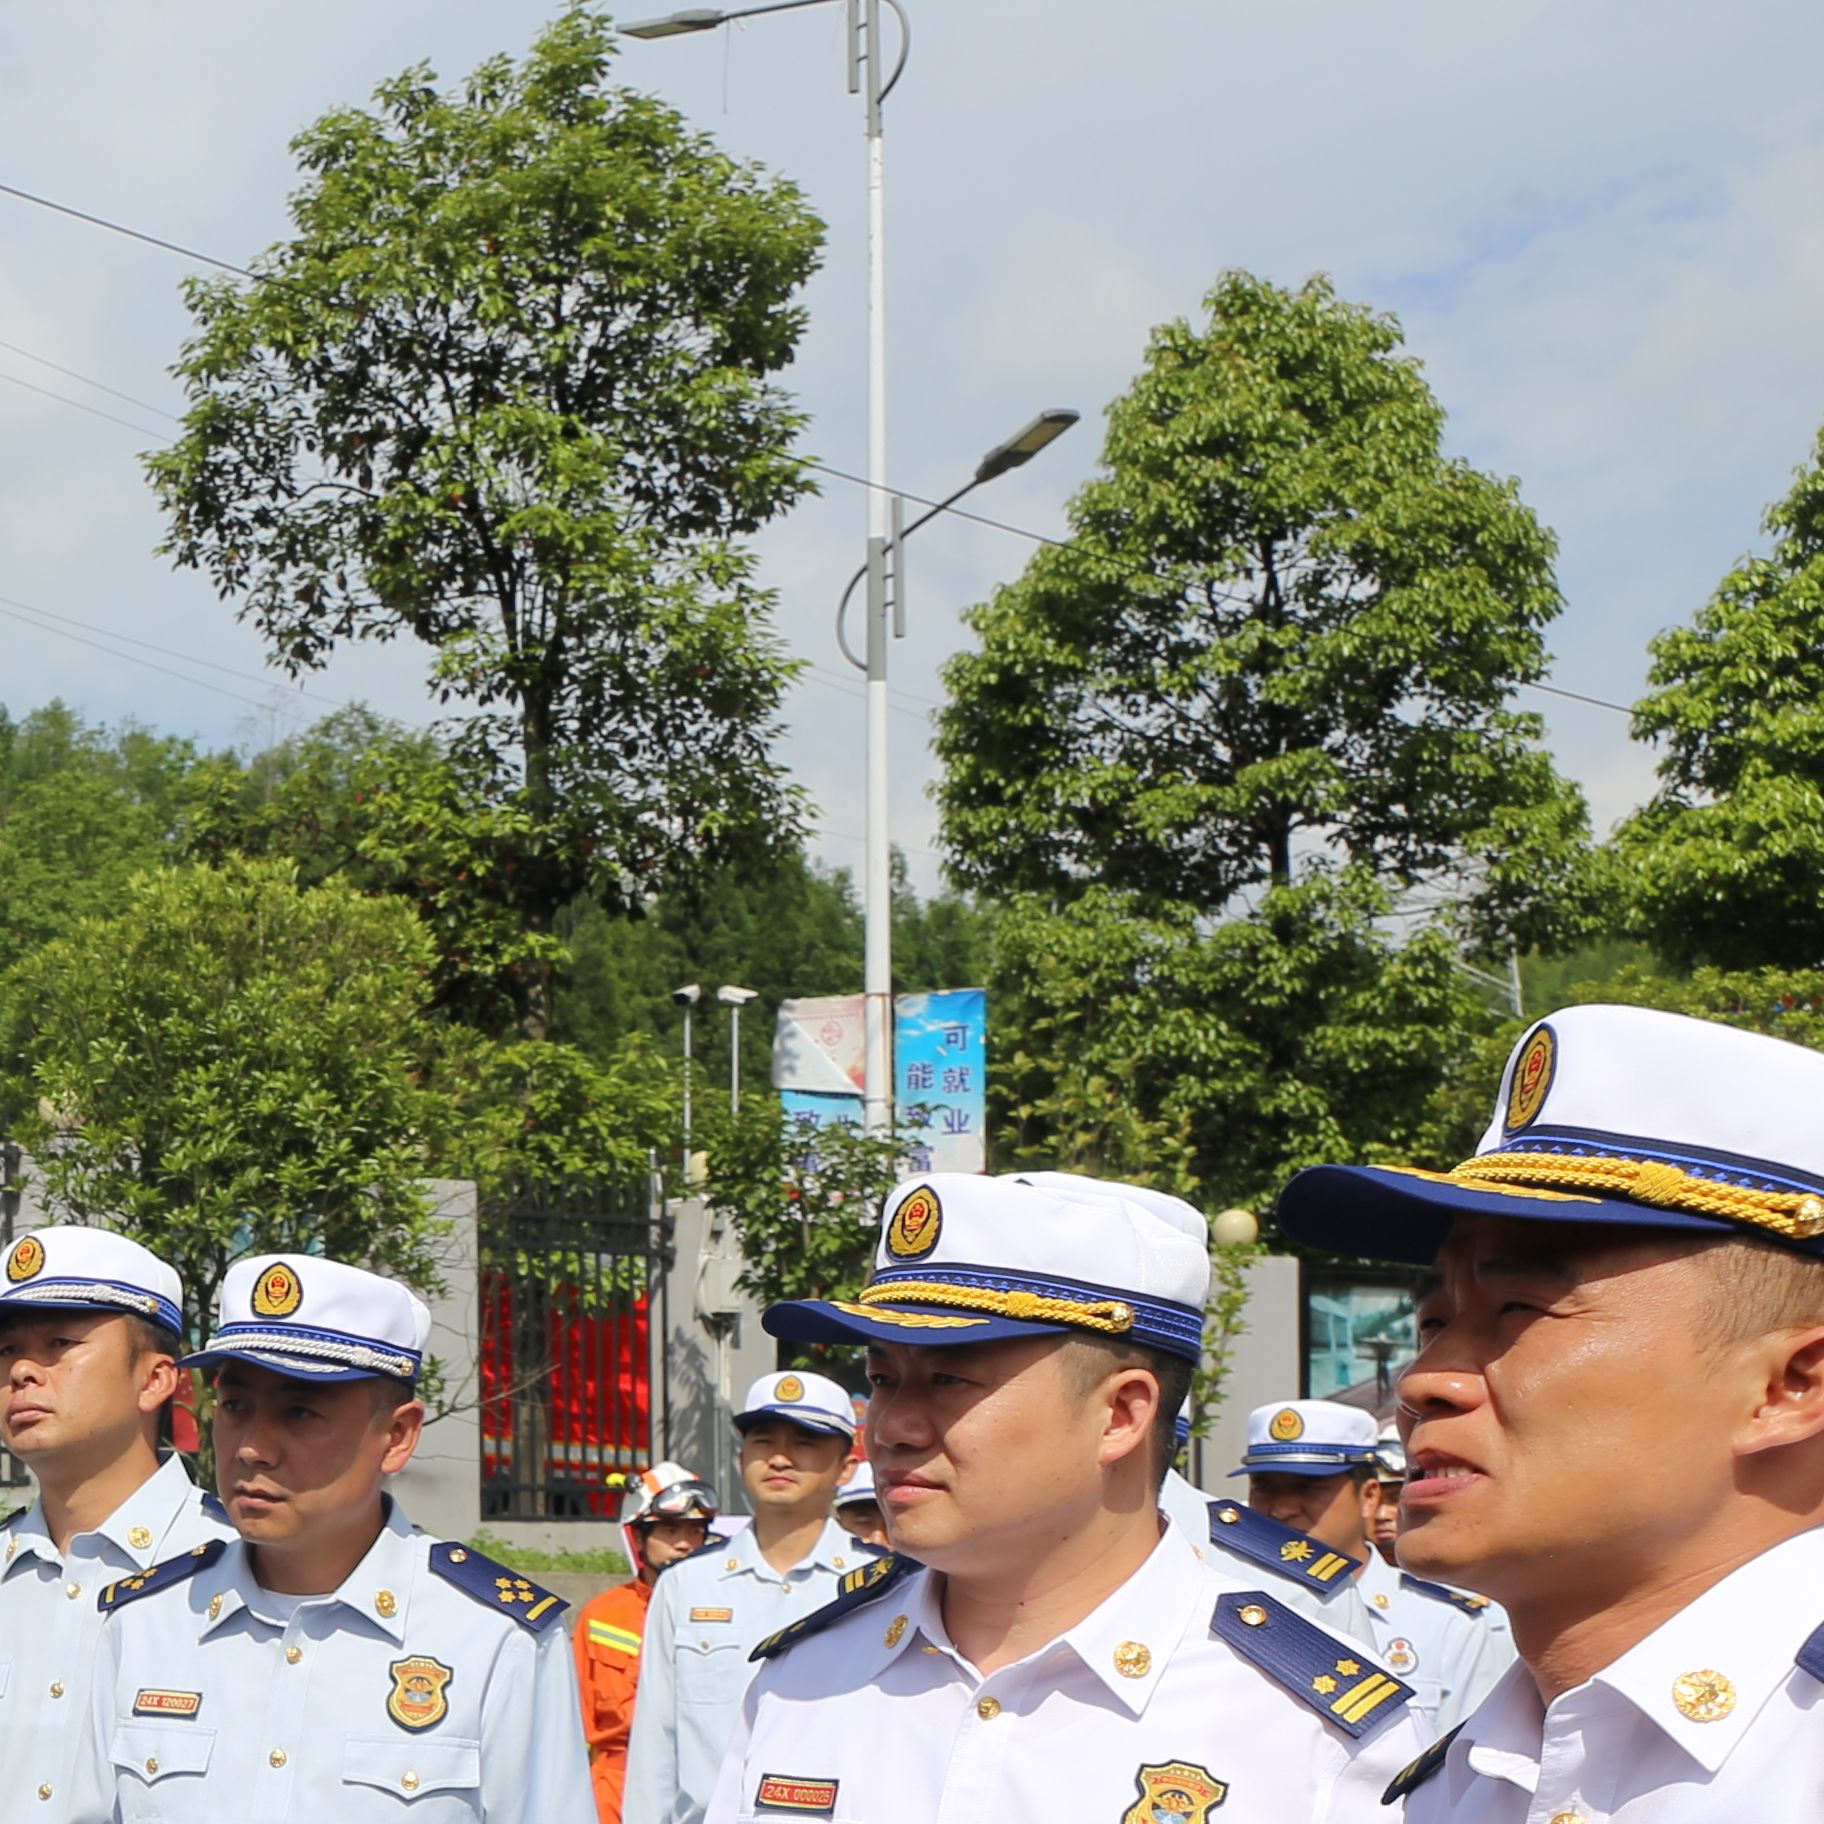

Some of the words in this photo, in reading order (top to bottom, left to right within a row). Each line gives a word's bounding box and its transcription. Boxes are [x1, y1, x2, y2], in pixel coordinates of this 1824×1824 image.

[942, 1024, 971, 1136] 可就业
[763, 1785, 790, 1800] 24X
